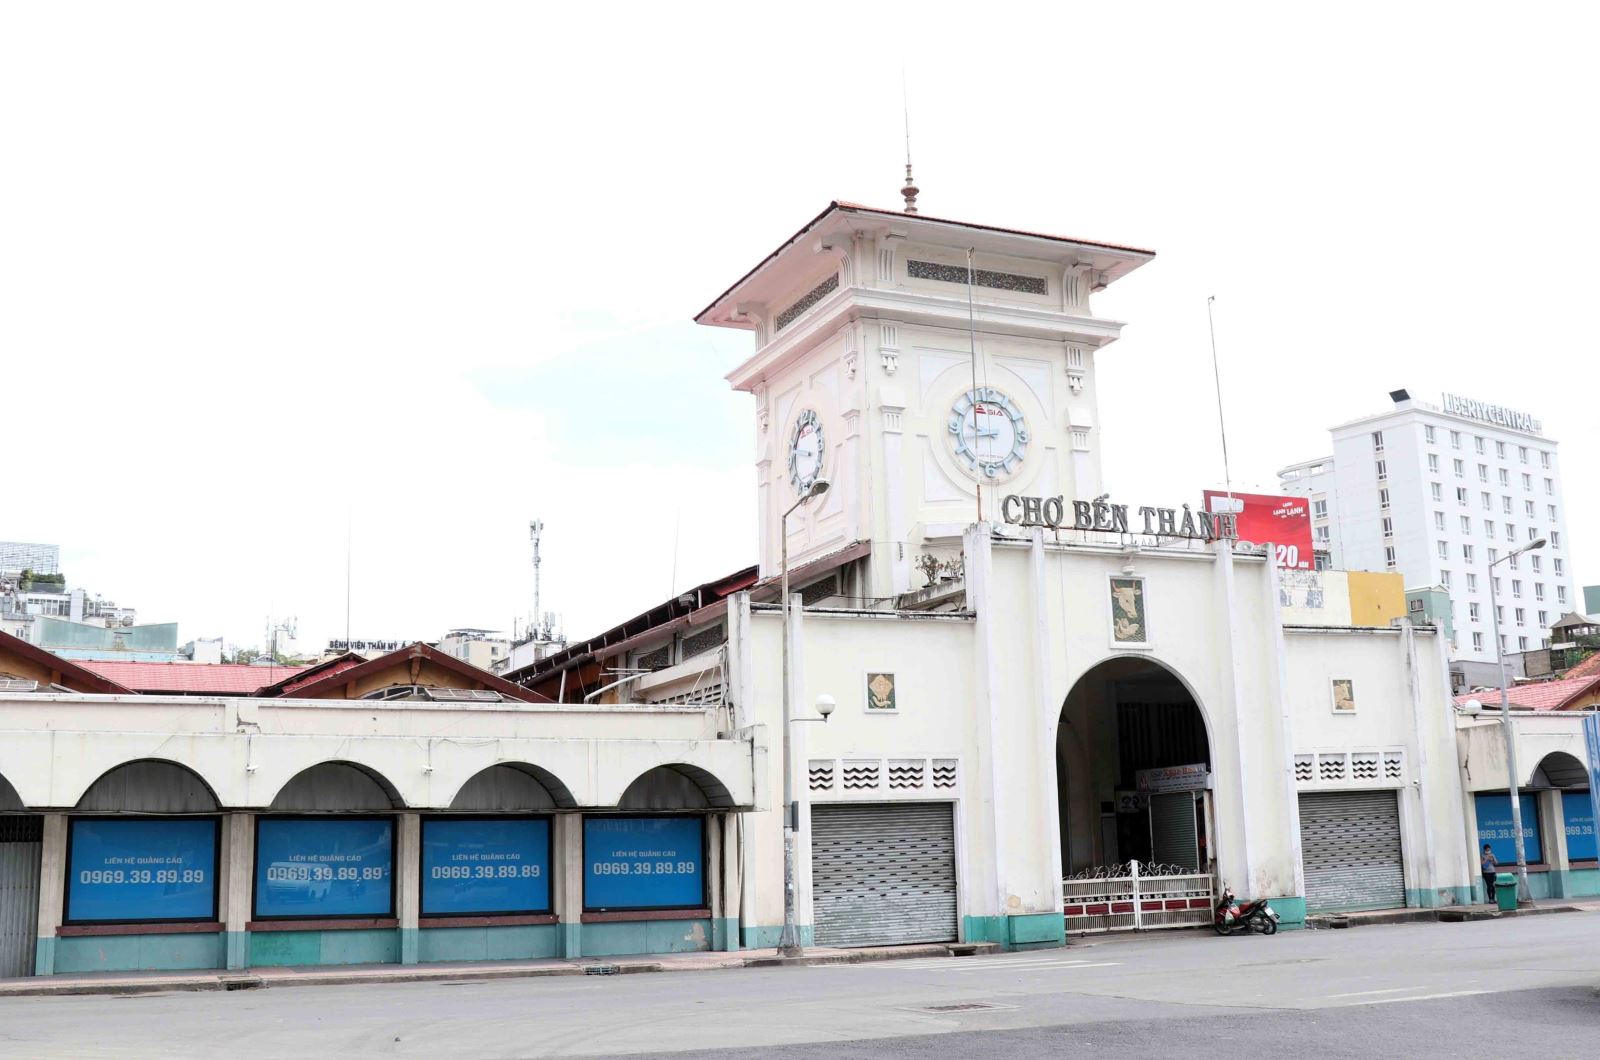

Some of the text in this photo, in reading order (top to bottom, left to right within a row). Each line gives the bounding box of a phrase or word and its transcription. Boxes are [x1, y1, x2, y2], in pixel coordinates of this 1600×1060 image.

[1001, 493, 1239, 541] CHỢ BẾN THÀNH
[267, 867, 382, 881] 0969.39.89.89
[431, 865, 540, 879] 0969.39.89.89
[593, 862, 695, 875] 0969.39.89.89
[80, 869, 204, 884] 0969.39.89.89
